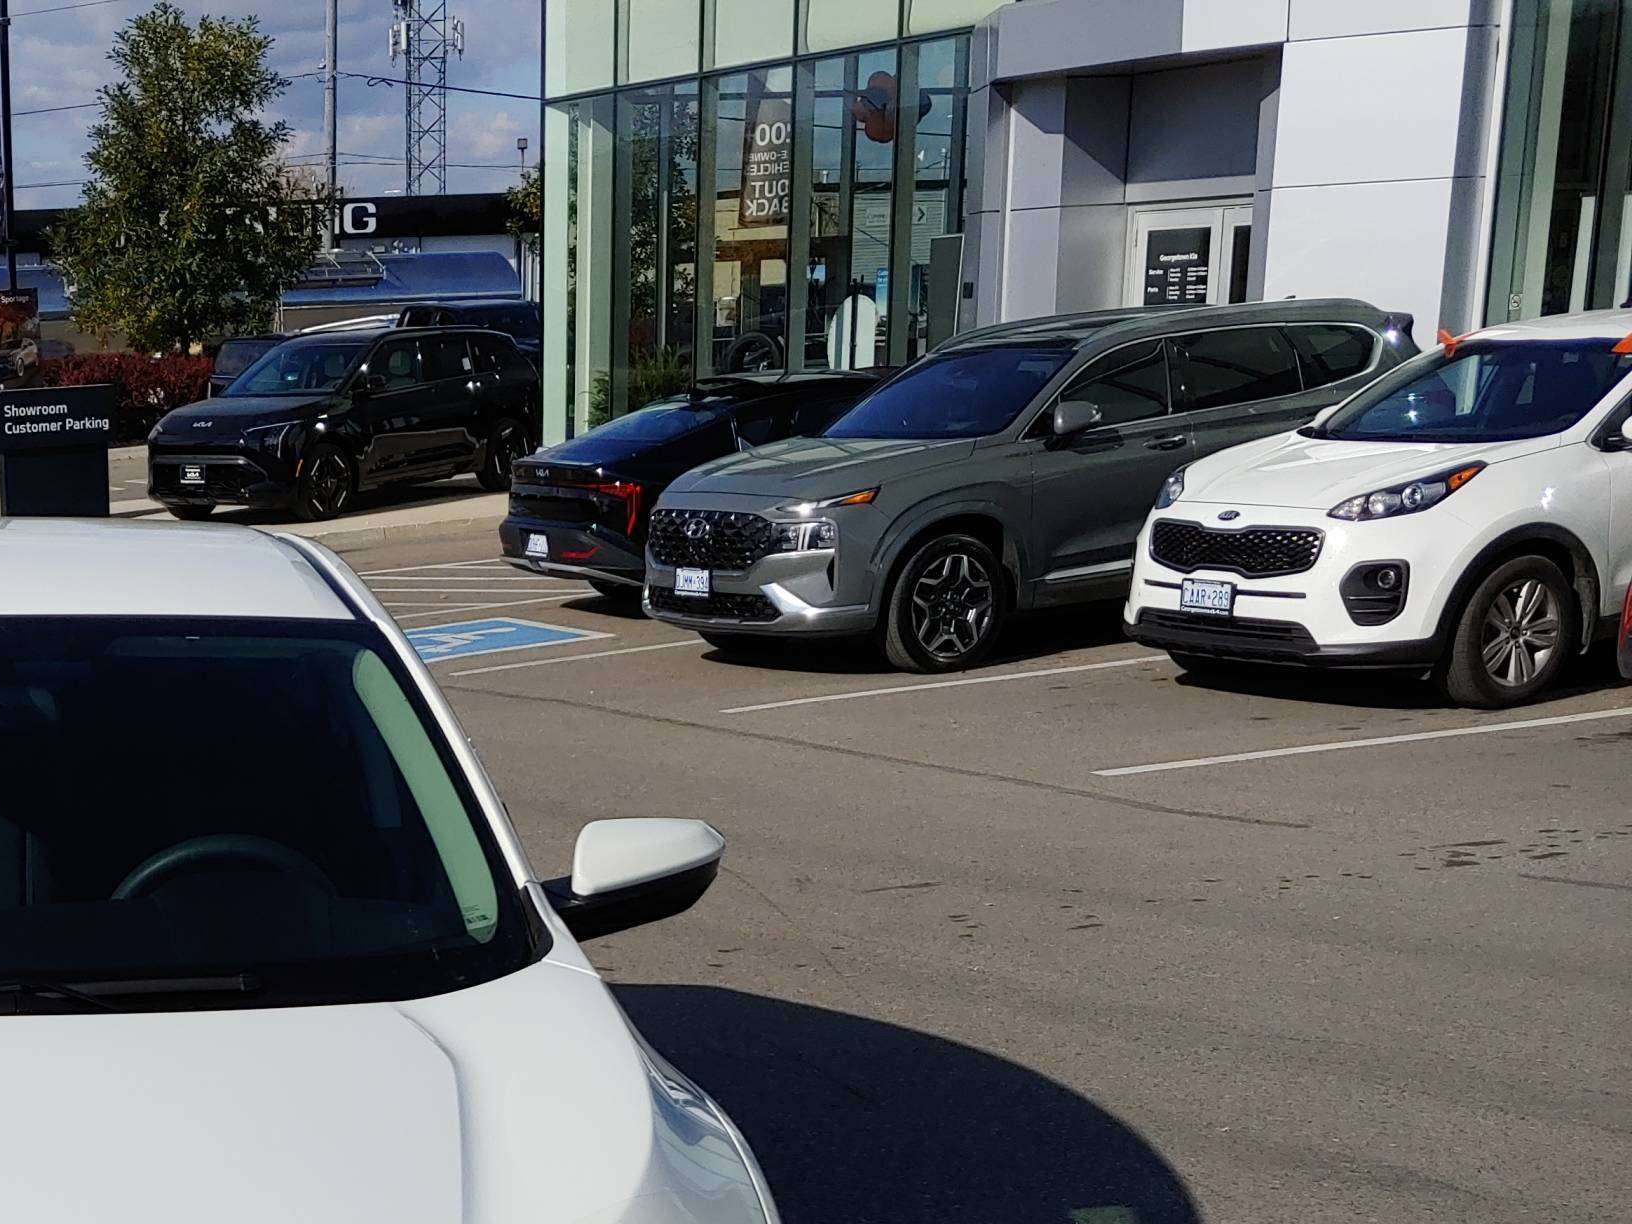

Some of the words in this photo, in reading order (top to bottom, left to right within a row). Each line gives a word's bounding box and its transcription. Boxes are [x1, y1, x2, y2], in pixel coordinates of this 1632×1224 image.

[3, 404, 68, 418] Showroom
[4, 421, 63, 435] Customer
[65, 417, 110, 431] Parking
[1211, 590, 1229, 607] 289
